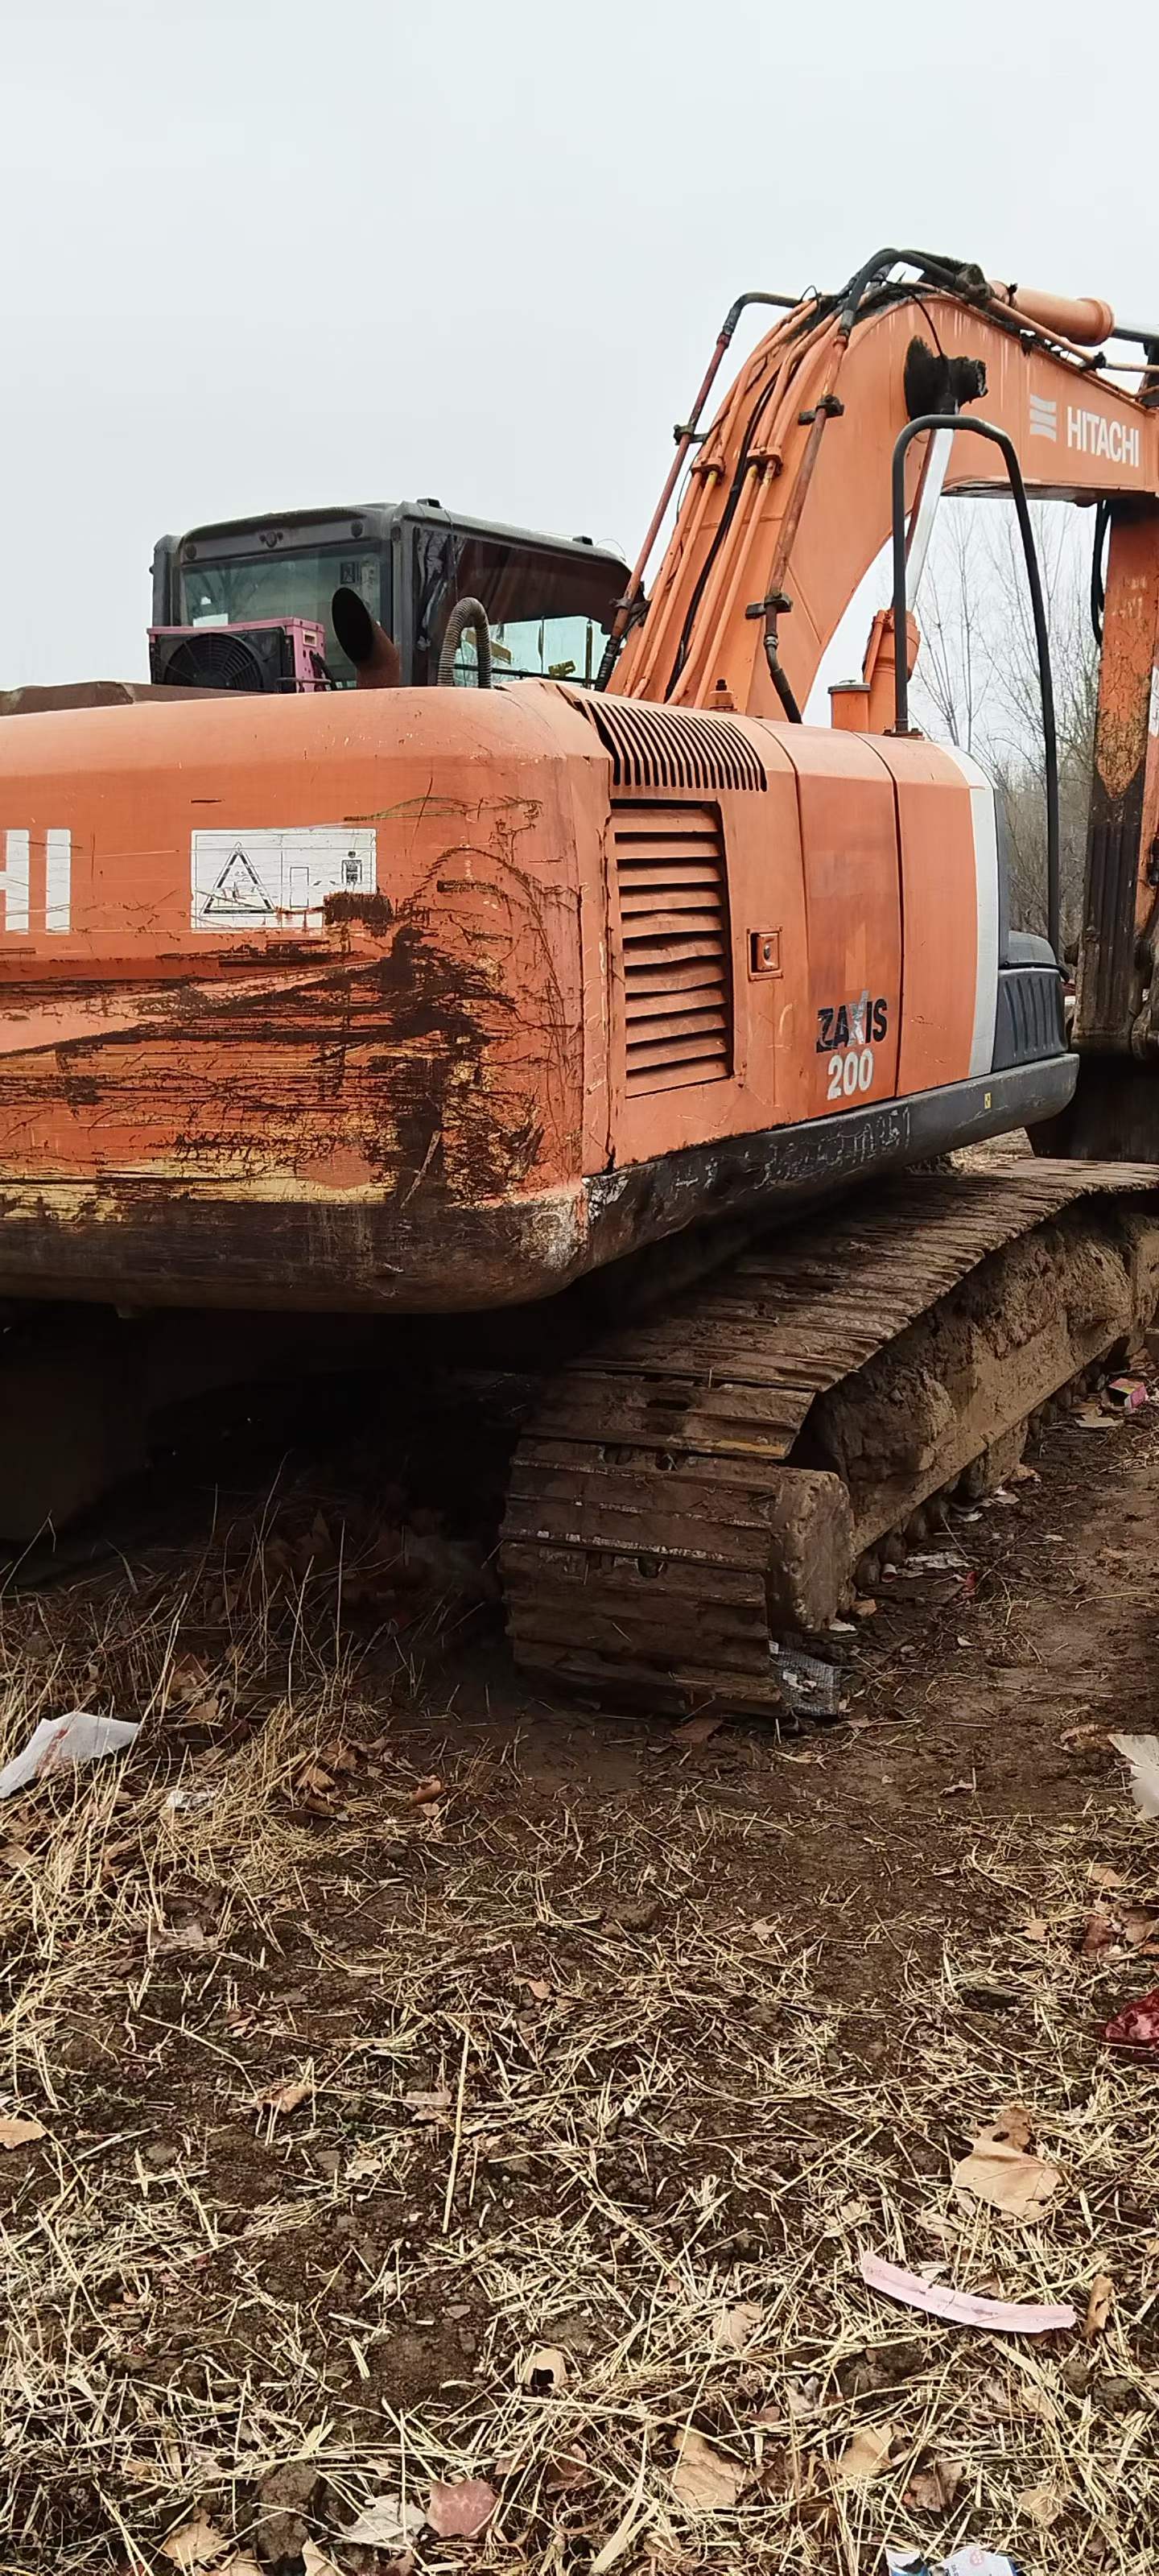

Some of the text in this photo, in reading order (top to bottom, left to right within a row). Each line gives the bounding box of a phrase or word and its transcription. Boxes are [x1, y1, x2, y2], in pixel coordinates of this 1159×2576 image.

[1067, 406, 1139, 467] HITACHI
[816, 990, 887, 1053] ZAXIS
[827, 1048, 873, 1100] 200
